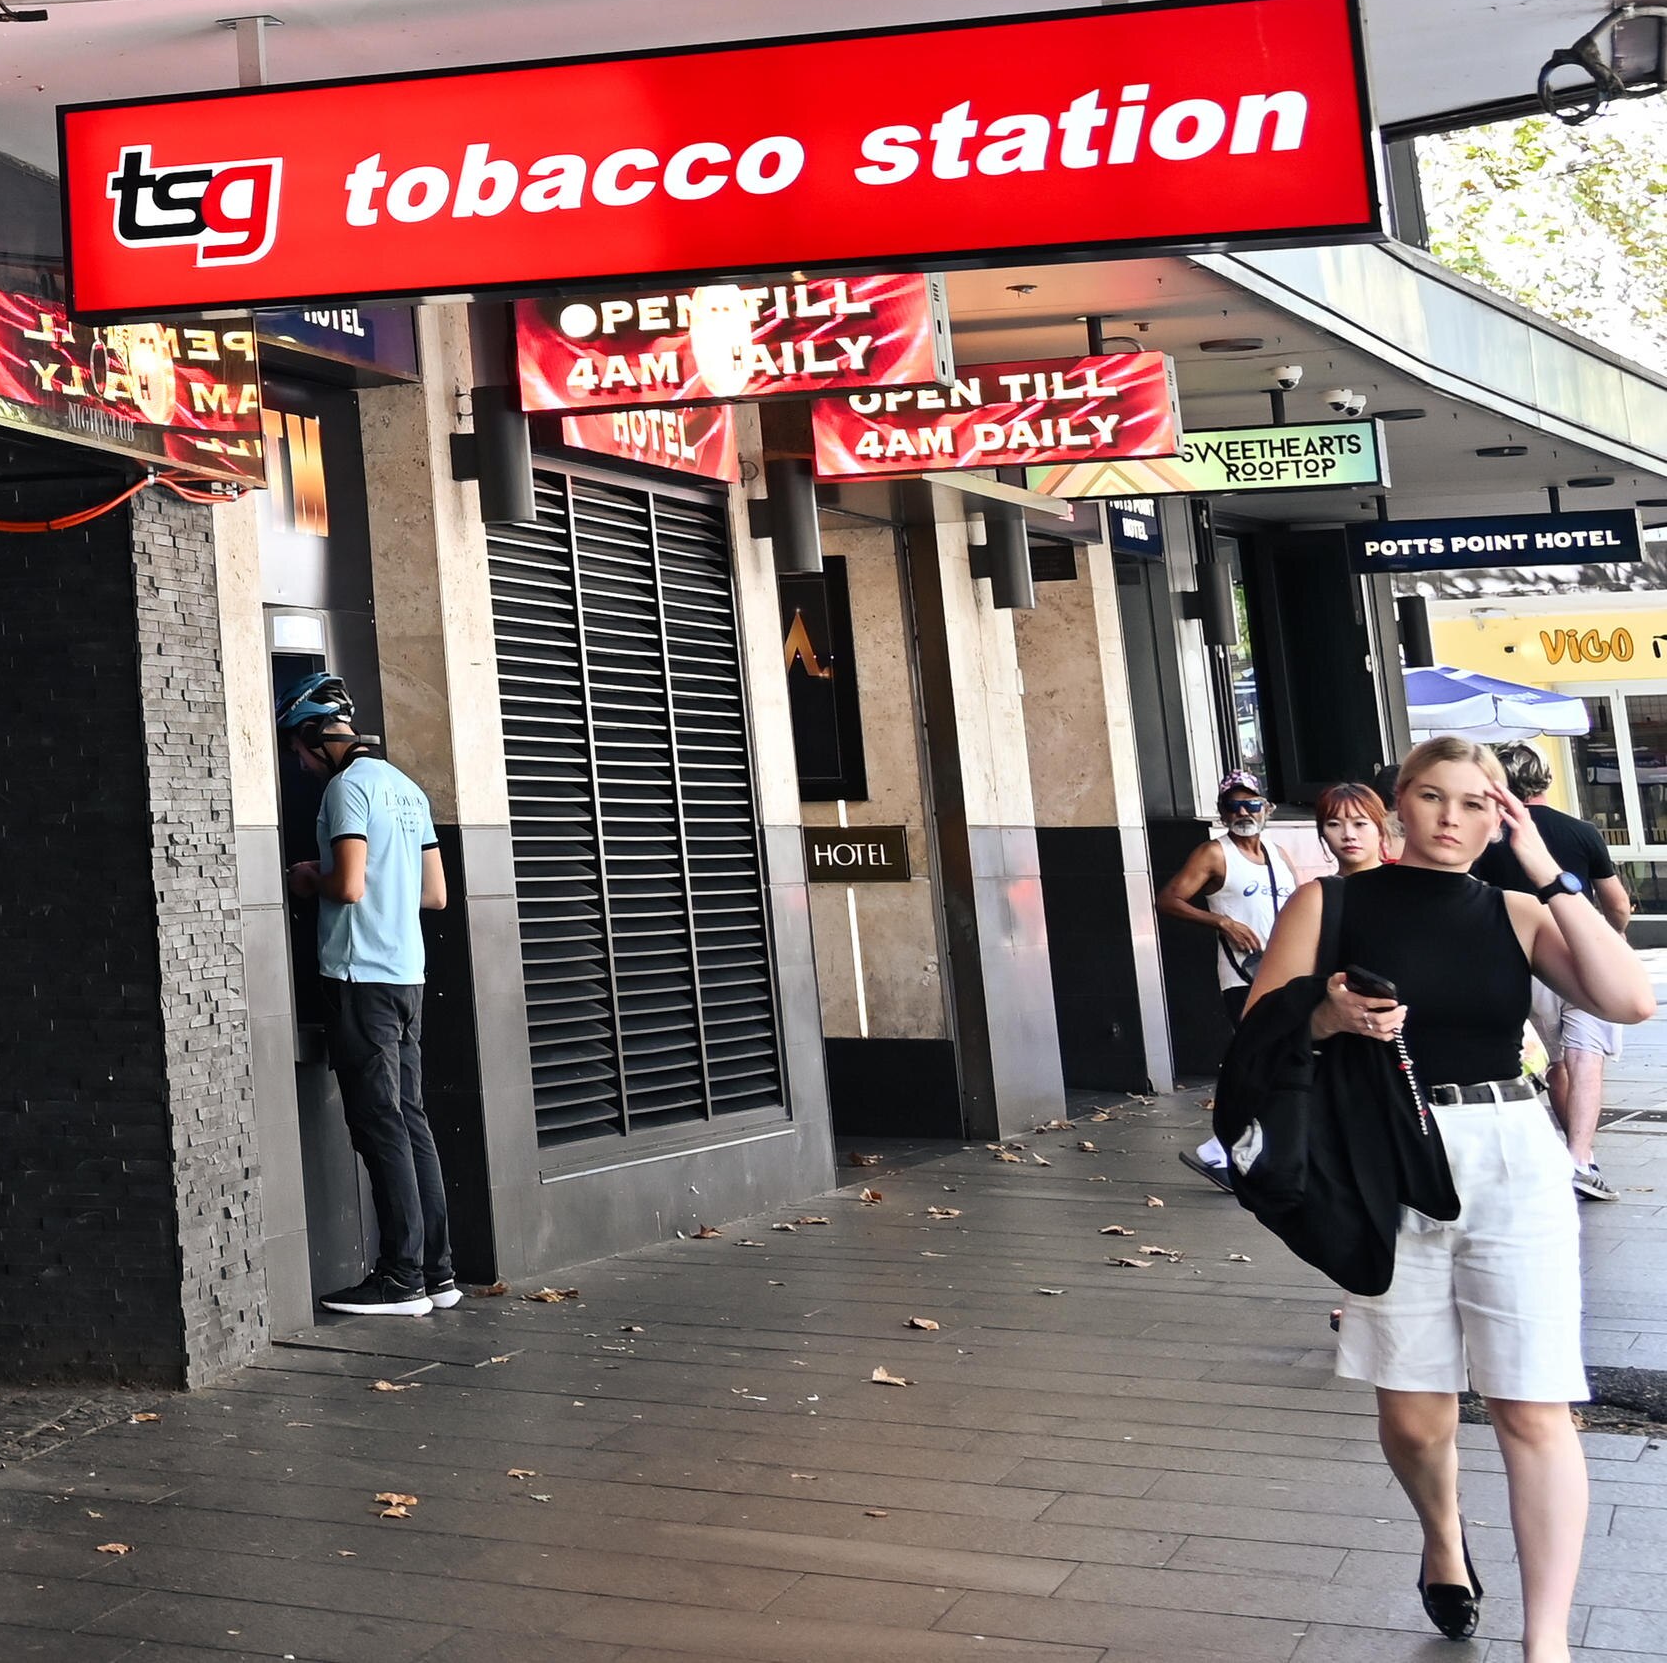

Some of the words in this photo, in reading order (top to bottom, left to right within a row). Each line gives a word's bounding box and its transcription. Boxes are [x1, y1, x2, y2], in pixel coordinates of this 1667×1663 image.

[108, 145, 281, 267] tsg
[344, 135, 805, 228] tobacco
[853, 85, 1307, 186] station
[566, 350, 681, 392] 4AM
[731, 335, 873, 379] AILY
[999, 368, 1118, 403] TILL
[67, 401, 135, 442] NIGHTCLUB
[612, 409, 698, 467] HOTEL
[854, 425, 955, 459] 4AM
[972, 413, 1121, 452] DAILY
[1182, 433, 1363, 465] SWEETHEARTS
[264, 408, 329, 538] TM
[1226, 457, 1337, 483] ROOFTOP
[1364, 537, 1445, 557] POTTS
[1451, 533, 1528, 554] POINT
[1534, 529, 1621, 550] HOTEL
[813, 843, 894, 867] HOTEL
